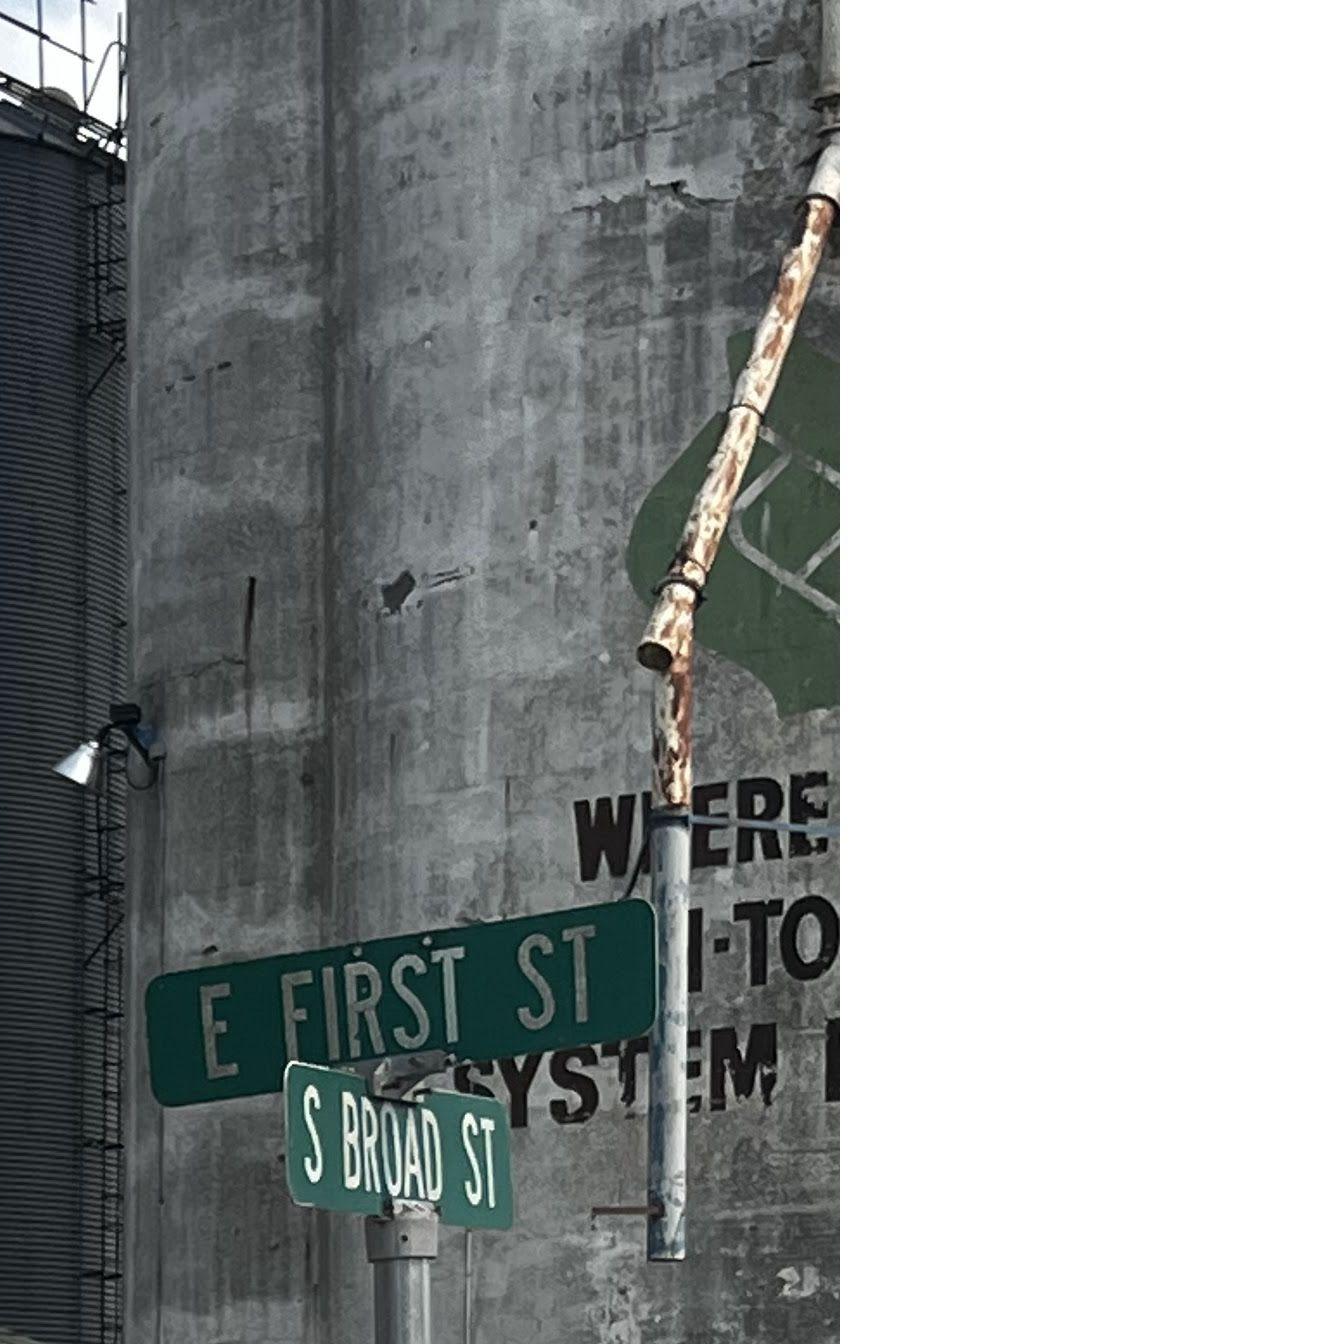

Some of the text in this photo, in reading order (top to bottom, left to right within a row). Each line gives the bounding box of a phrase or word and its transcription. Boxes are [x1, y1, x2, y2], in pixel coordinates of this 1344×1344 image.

[200, 925, 597, 1081] E FIRST ST
[303, 1085, 497, 1209] S BROAD ST
